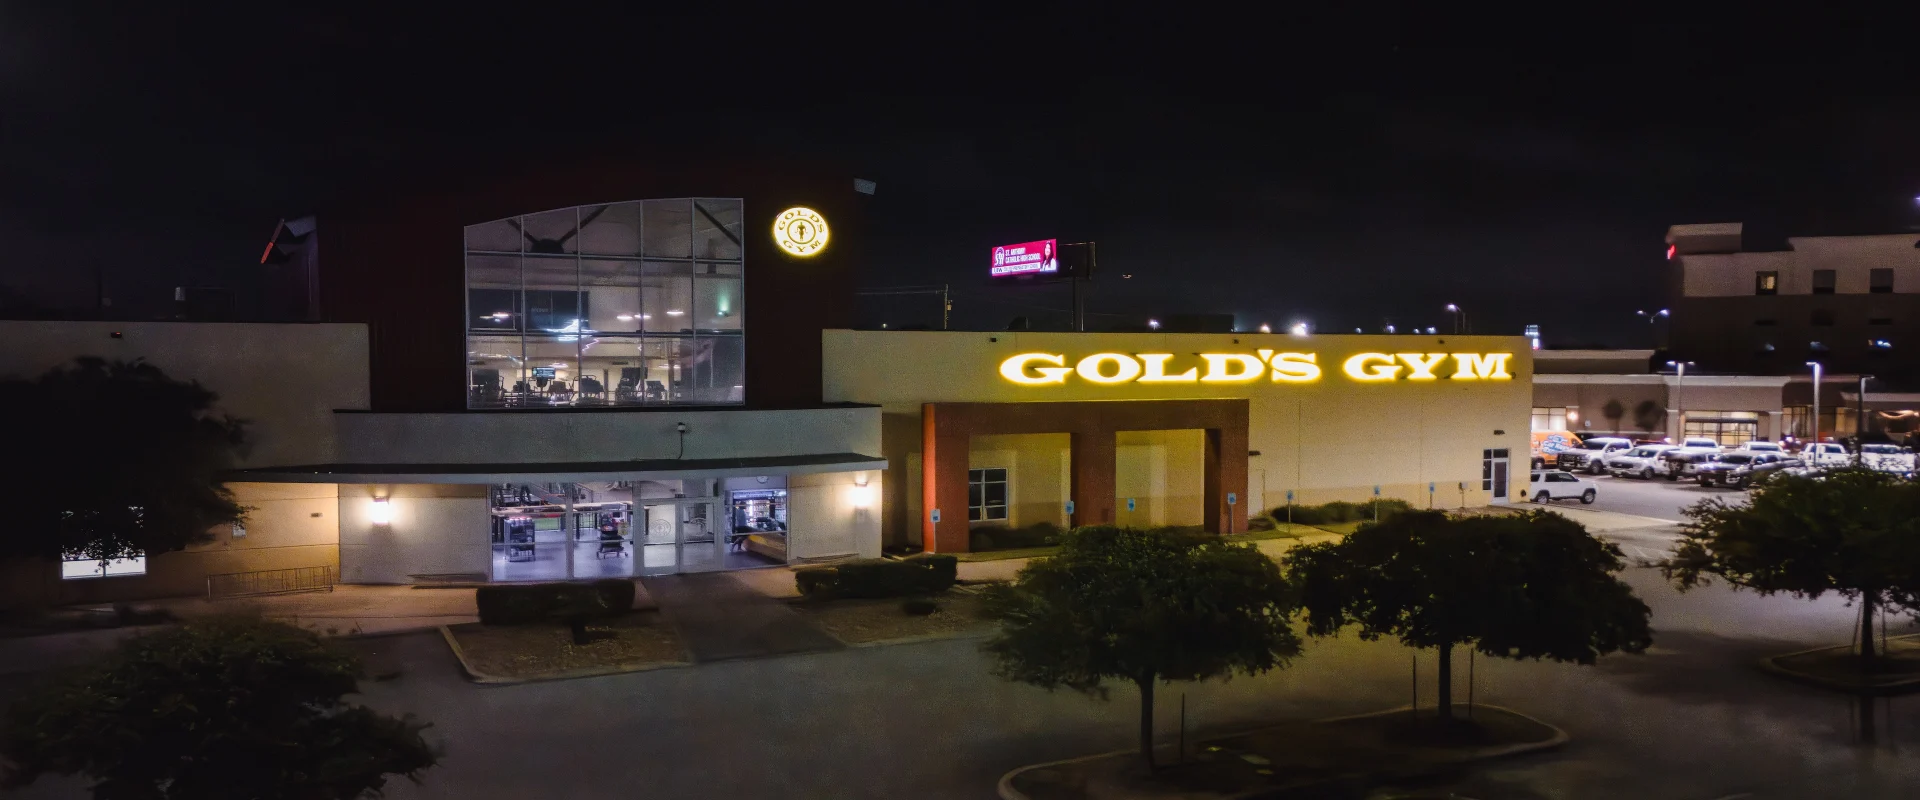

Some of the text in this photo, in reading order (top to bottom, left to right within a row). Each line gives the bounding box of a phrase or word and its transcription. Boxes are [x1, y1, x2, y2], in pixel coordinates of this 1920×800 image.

[783, 240, 821, 252] GYM
[999, 349, 1513, 384] GOLD'S GYM
